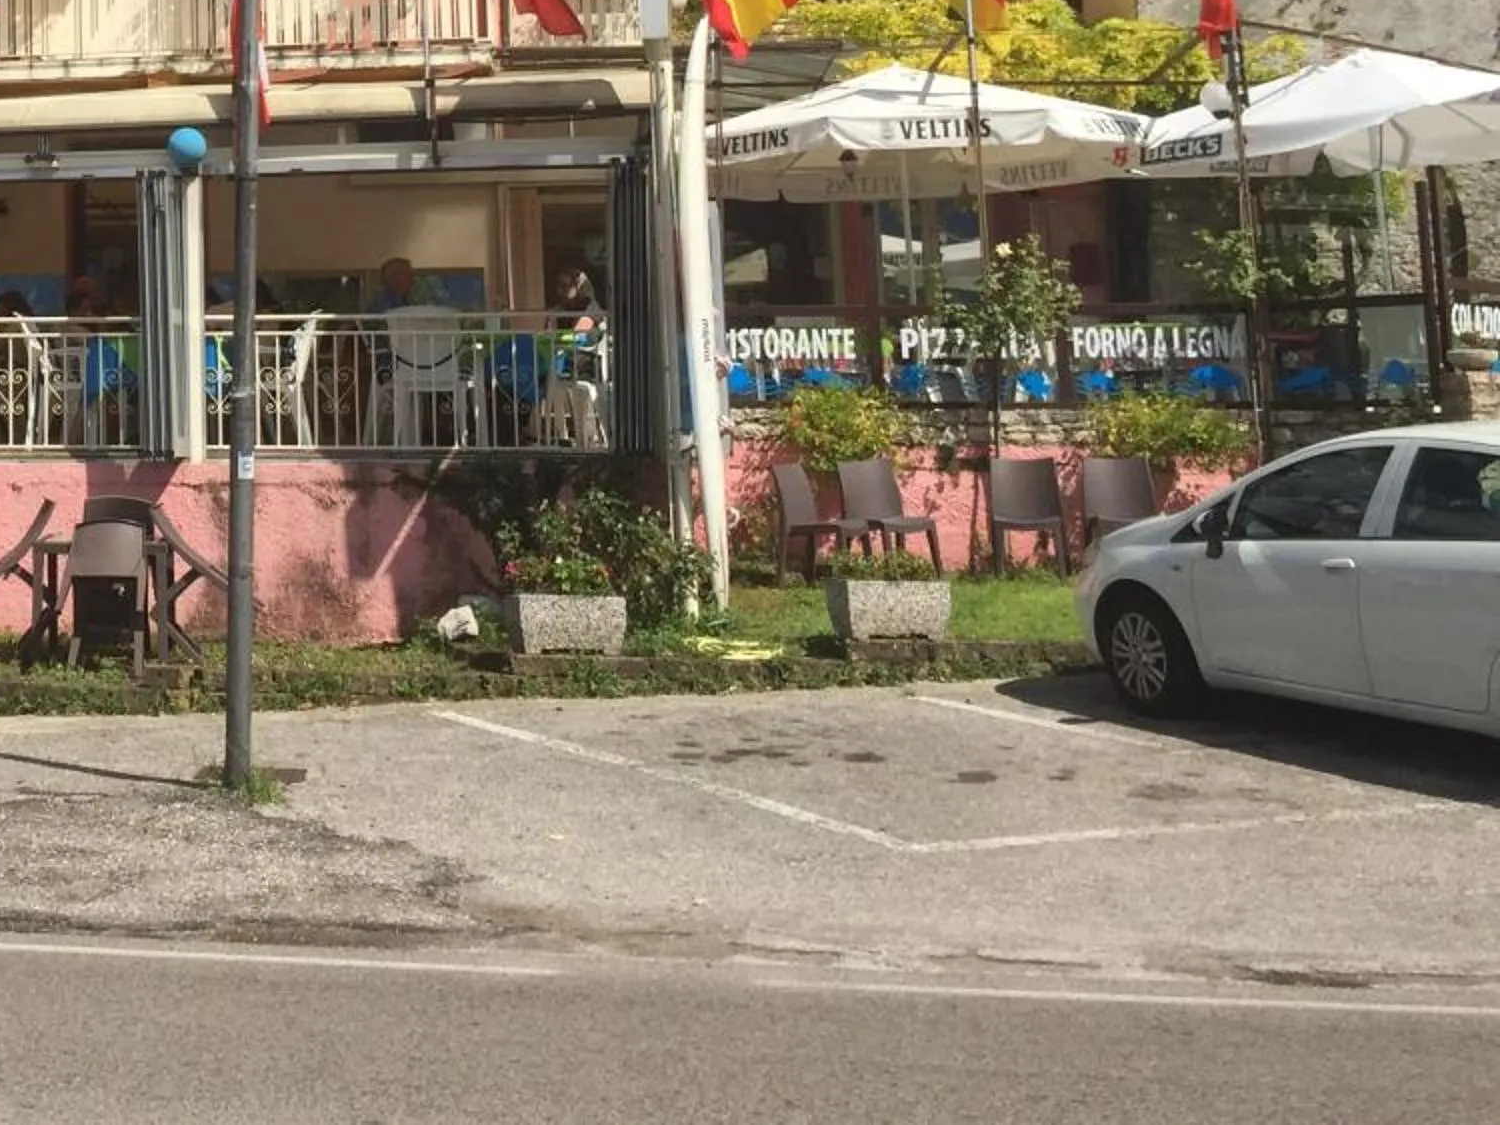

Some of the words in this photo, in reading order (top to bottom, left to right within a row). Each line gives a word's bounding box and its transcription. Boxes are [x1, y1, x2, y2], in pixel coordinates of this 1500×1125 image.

[721, 127, 789, 156] VELTINS
[899, 118, 992, 140] VELTINS
[726, 327, 857, 361] ISTORANTE
[1071, 325, 1148, 359] FORNO
[1153, 325, 1169, 359] A
[1172, 320, 1247, 359] LEGNA
